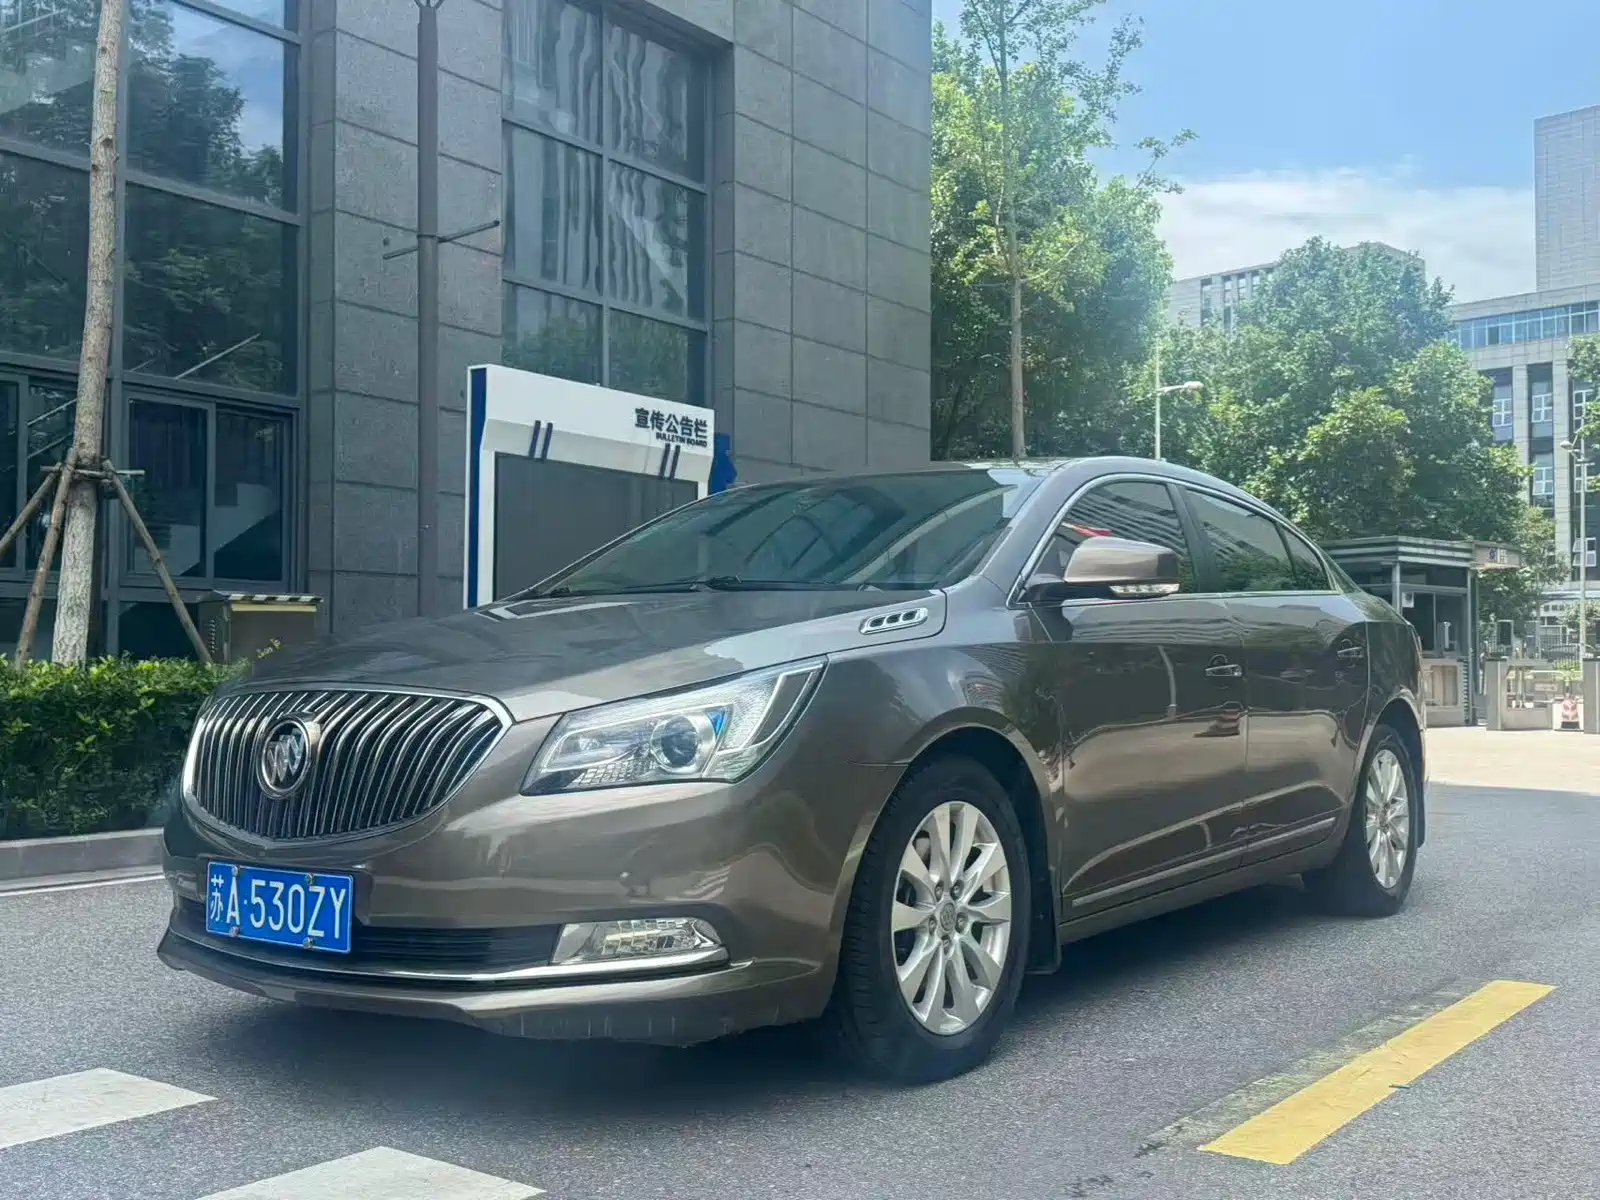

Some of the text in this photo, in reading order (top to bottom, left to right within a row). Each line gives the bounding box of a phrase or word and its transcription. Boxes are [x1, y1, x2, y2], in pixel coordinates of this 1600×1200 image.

[635, 408, 707, 439] 宣传公告栏
[656, 432, 708, 447] BULLETIN BOARD
